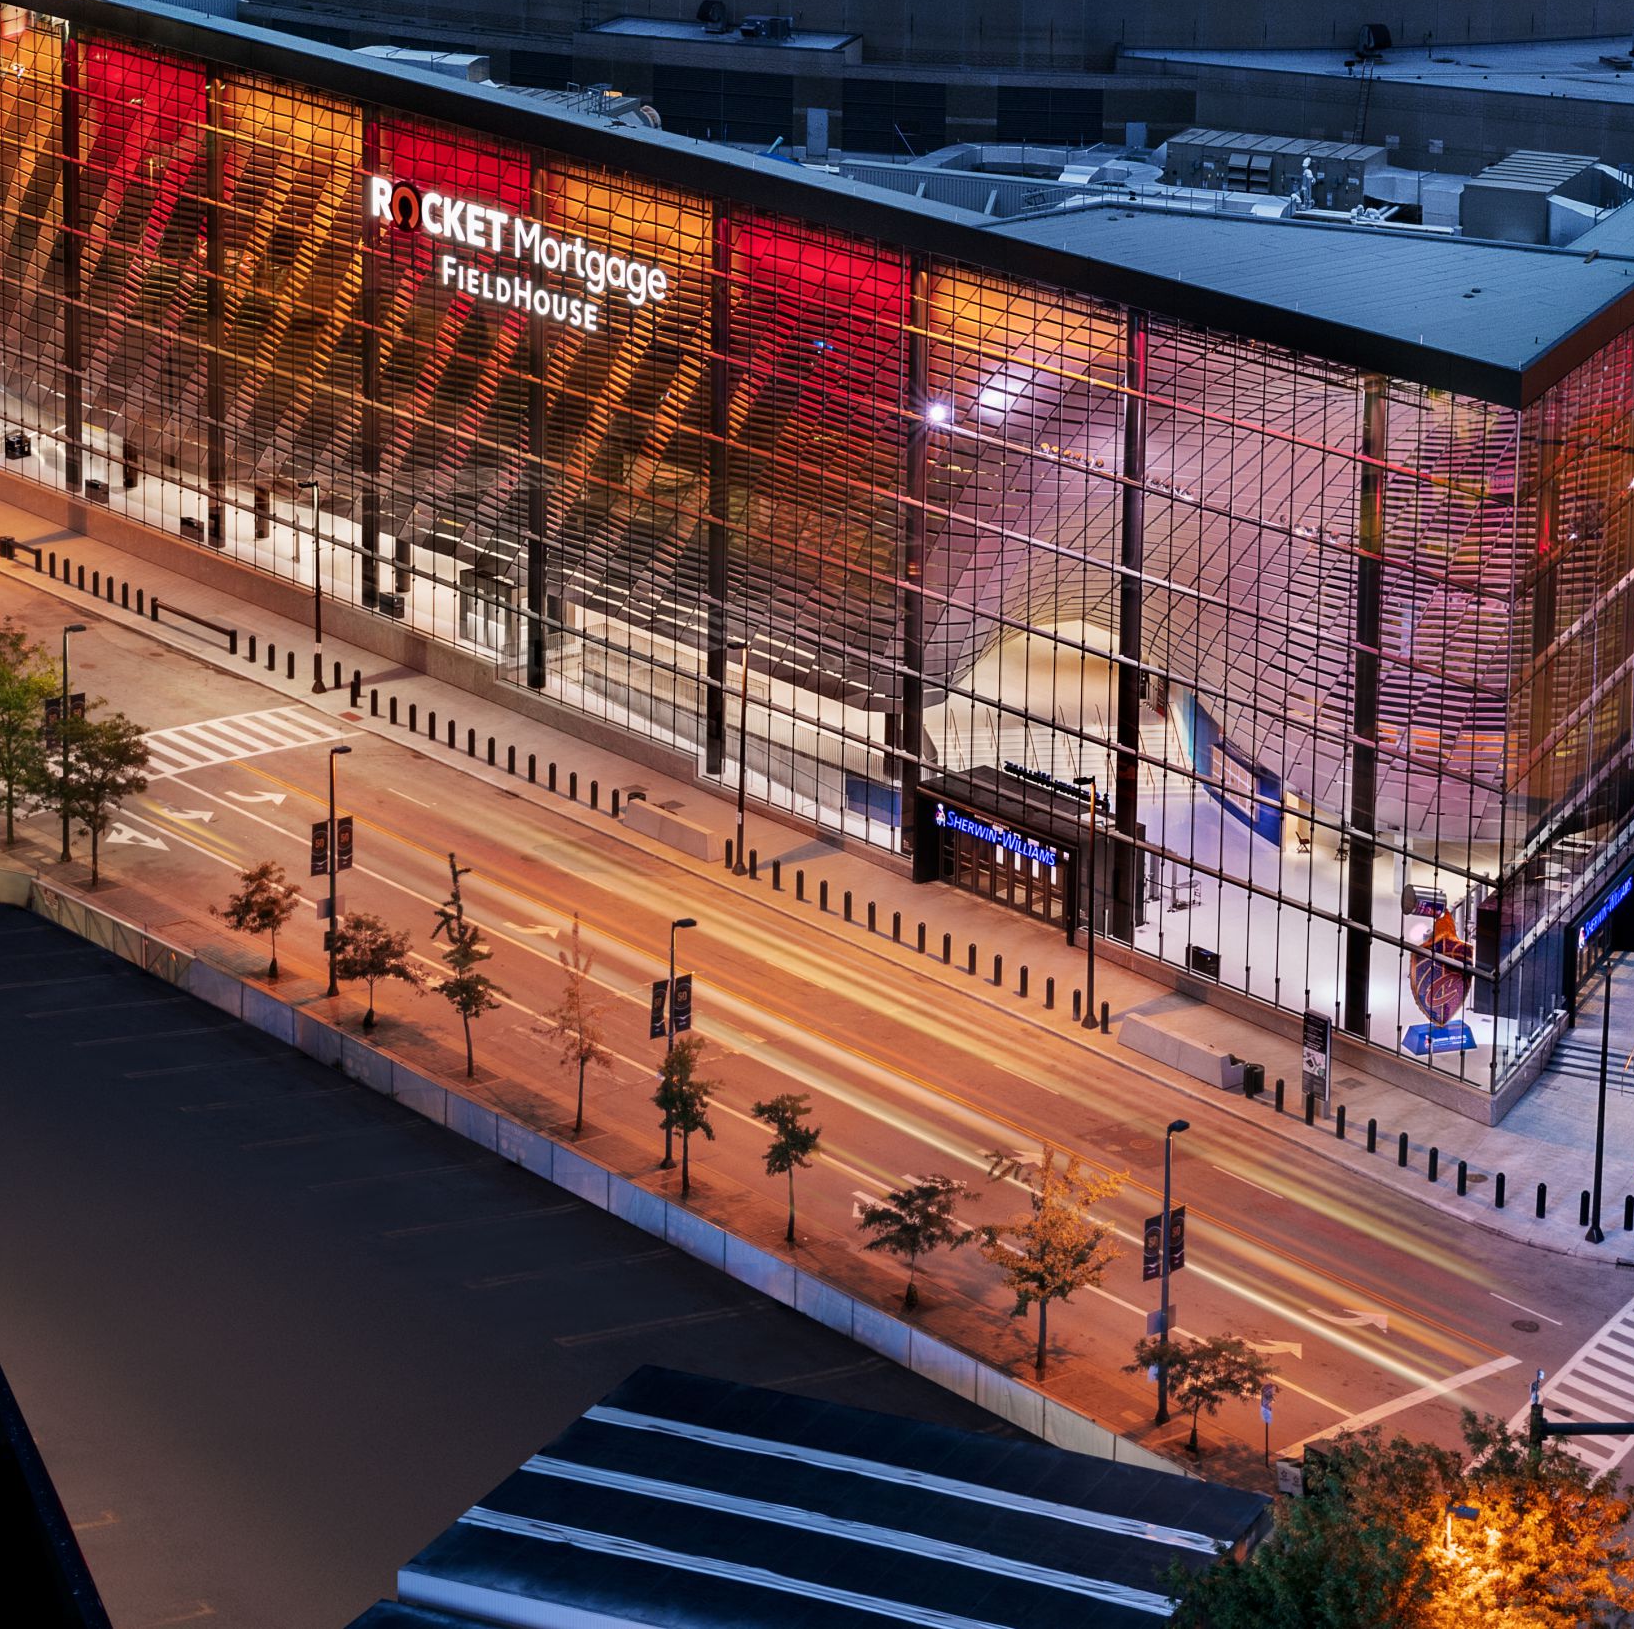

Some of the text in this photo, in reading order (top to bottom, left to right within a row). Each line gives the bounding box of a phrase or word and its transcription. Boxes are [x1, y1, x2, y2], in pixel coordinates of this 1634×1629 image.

[370, 175, 668, 306] ROCKET Mortgage
[441, 254, 599, 332] FIELDHOUSE
[315, 838, 325, 849] 50
[946, 810, 1057, 867] SHERWIN-WILLIAMS
[677, 991, 688, 1002] 50
